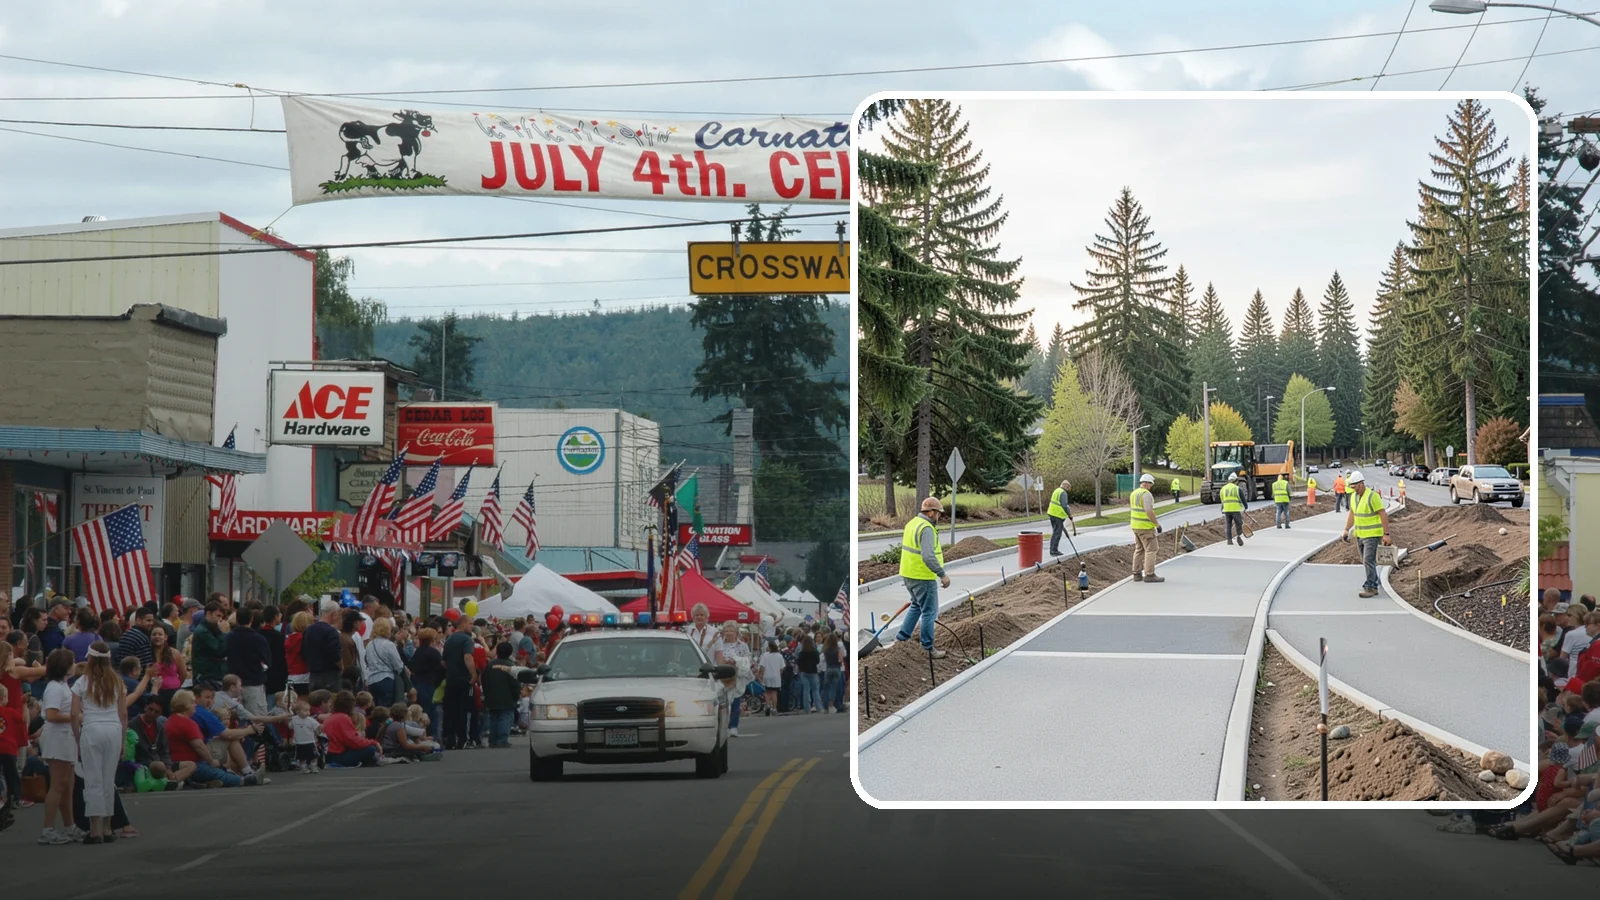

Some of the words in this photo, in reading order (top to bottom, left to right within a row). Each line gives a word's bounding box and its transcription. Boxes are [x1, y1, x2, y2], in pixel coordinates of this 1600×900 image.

[481, 141, 605, 192] JULY
[632, 150, 746, 198] 4th.
[697, 254, 850, 280] CROSSWA
[282, 380, 373, 420] ACE
[405, 409, 452, 422] CEDAR
[283, 421, 370, 436] Hardware
[353, 467, 385, 482] Simpl
[96, 485, 124, 495] Vincent
[126, 486, 136, 494] de
[138, 486, 155, 495] Paul
[688, 526, 741, 535] CRNATION
[699, 535, 730, 543] GLASS
